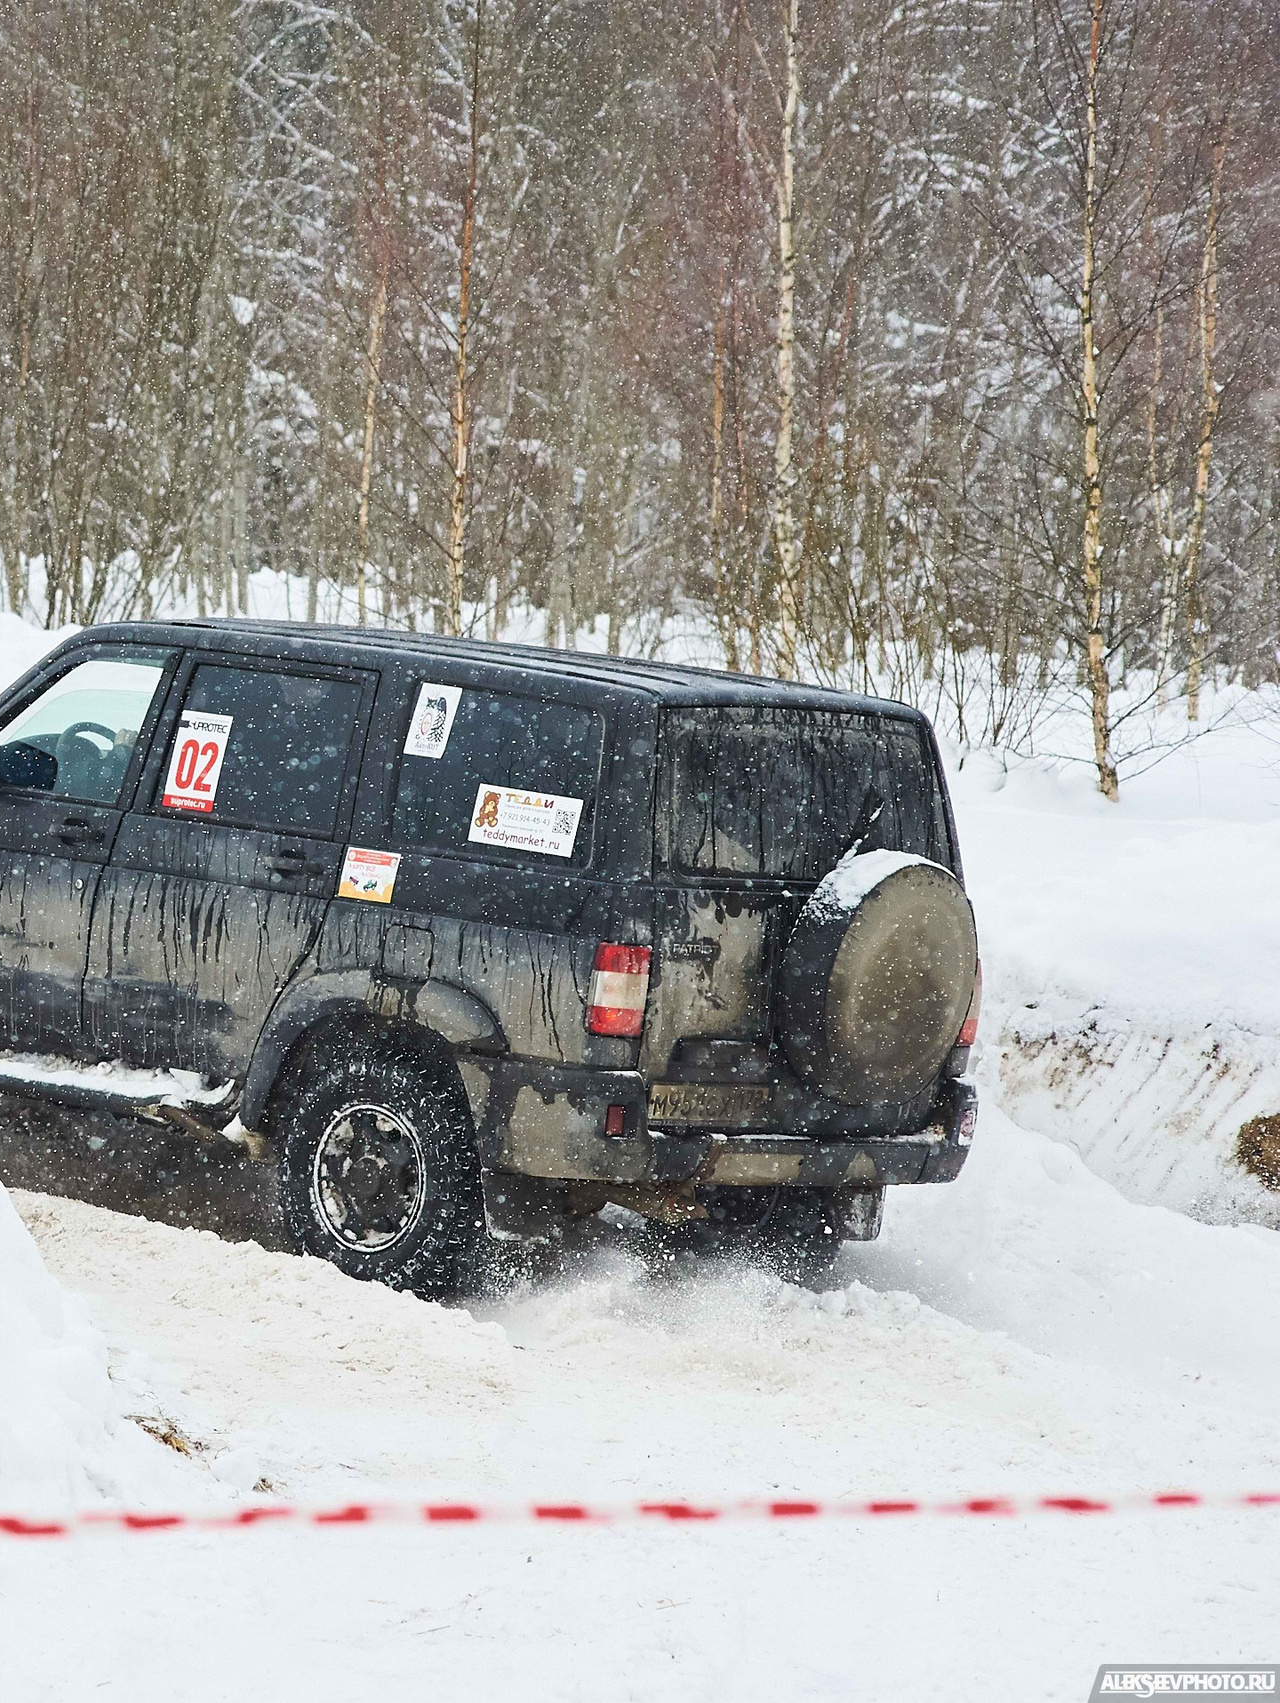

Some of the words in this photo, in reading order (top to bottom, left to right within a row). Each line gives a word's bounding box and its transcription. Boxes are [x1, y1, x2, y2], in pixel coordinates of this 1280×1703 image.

[175, 738, 219, 793] 02
[170, 796, 206, 809] suprotec.ru
[483, 828, 560, 850] teddymarket.ru
[673, 942, 719, 954] PATRIOT
